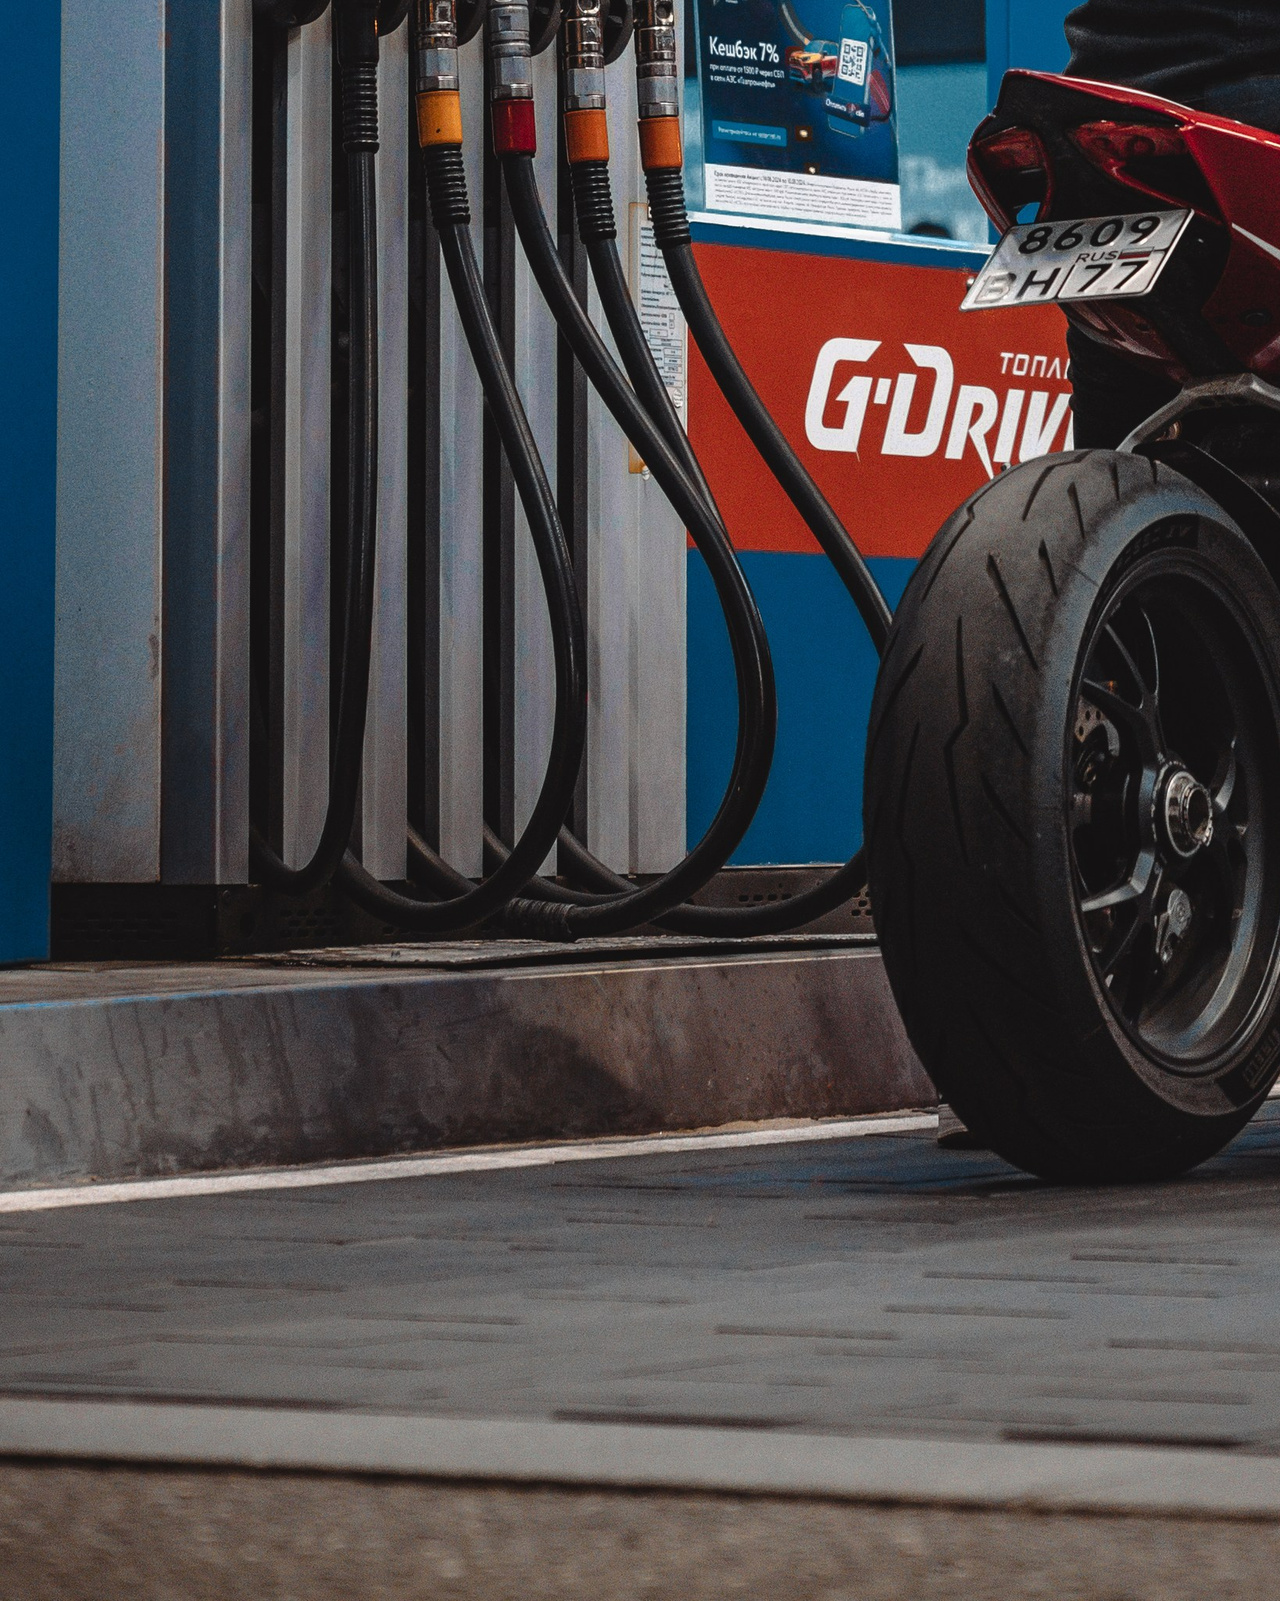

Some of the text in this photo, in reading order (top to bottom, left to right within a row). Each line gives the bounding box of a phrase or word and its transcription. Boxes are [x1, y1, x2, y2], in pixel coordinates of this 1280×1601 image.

[709, 36, 780, 63] Кешбэк 7%
[1018, 216, 1162, 255] 8609
[1075, 250, 1120, 263] RUS
[1078, 260, 1149, 292] 77
